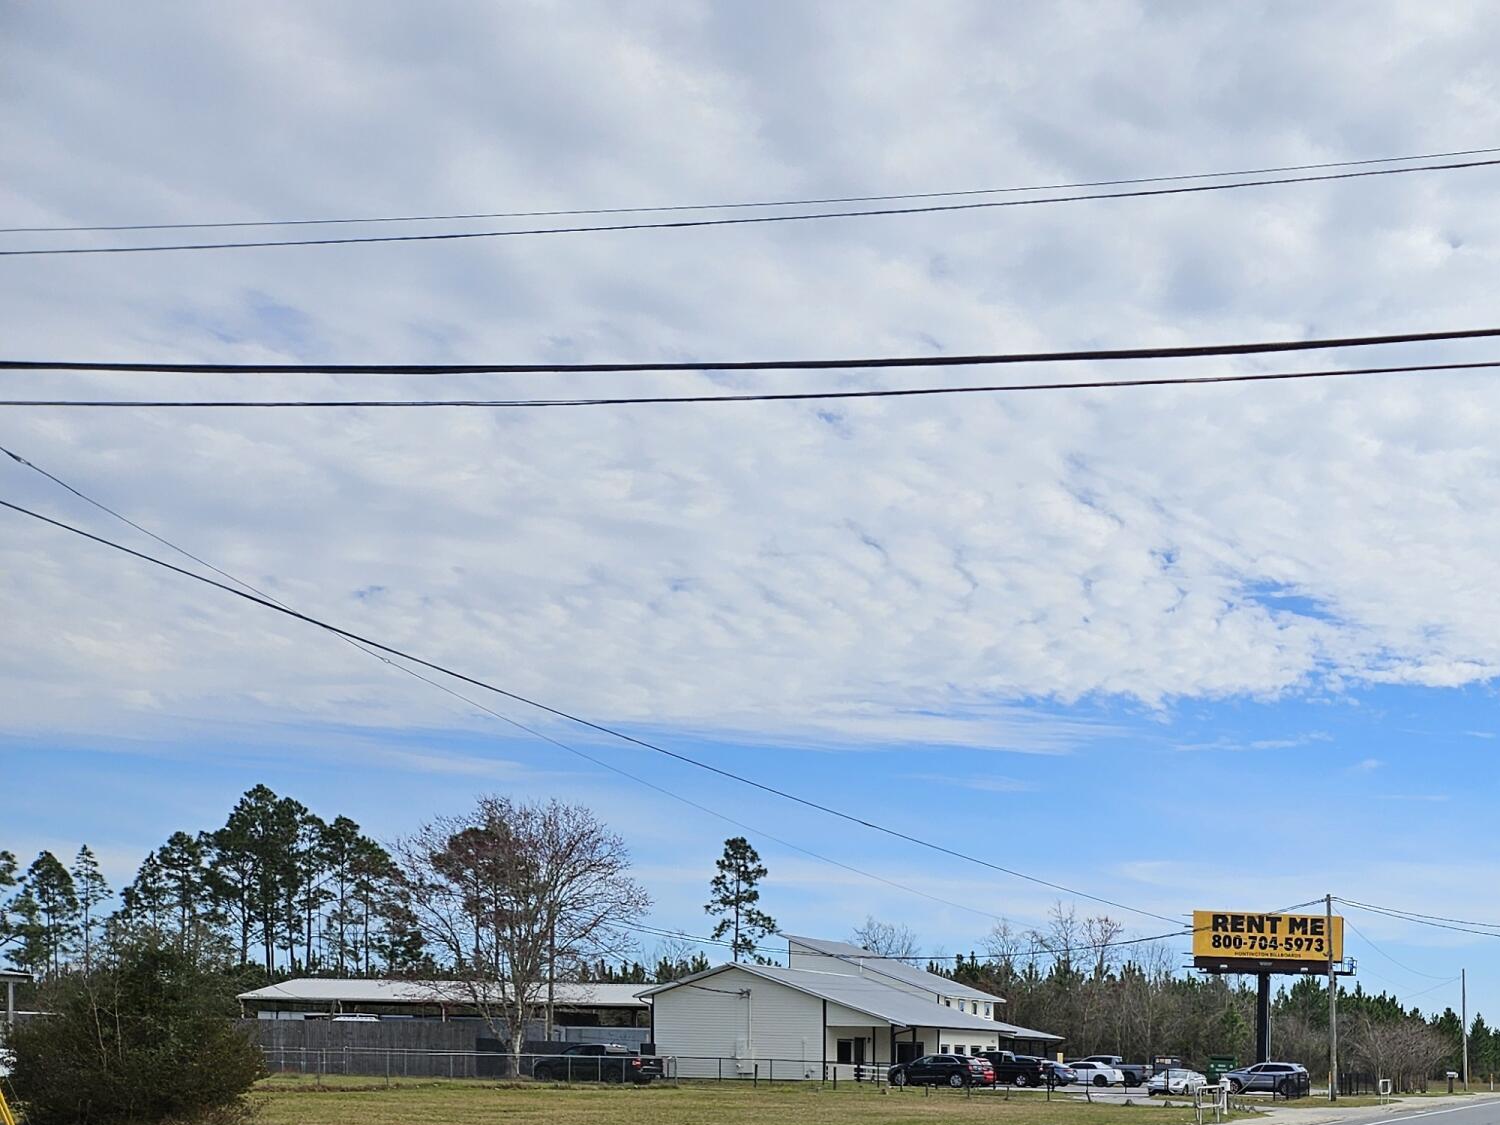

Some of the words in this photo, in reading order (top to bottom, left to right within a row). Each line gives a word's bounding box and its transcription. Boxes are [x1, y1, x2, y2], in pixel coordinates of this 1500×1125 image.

[1212, 914, 1282, 934] RENT
[1288, 917, 1325, 936] ME
[1212, 935, 1324, 952] 800-704-5973
